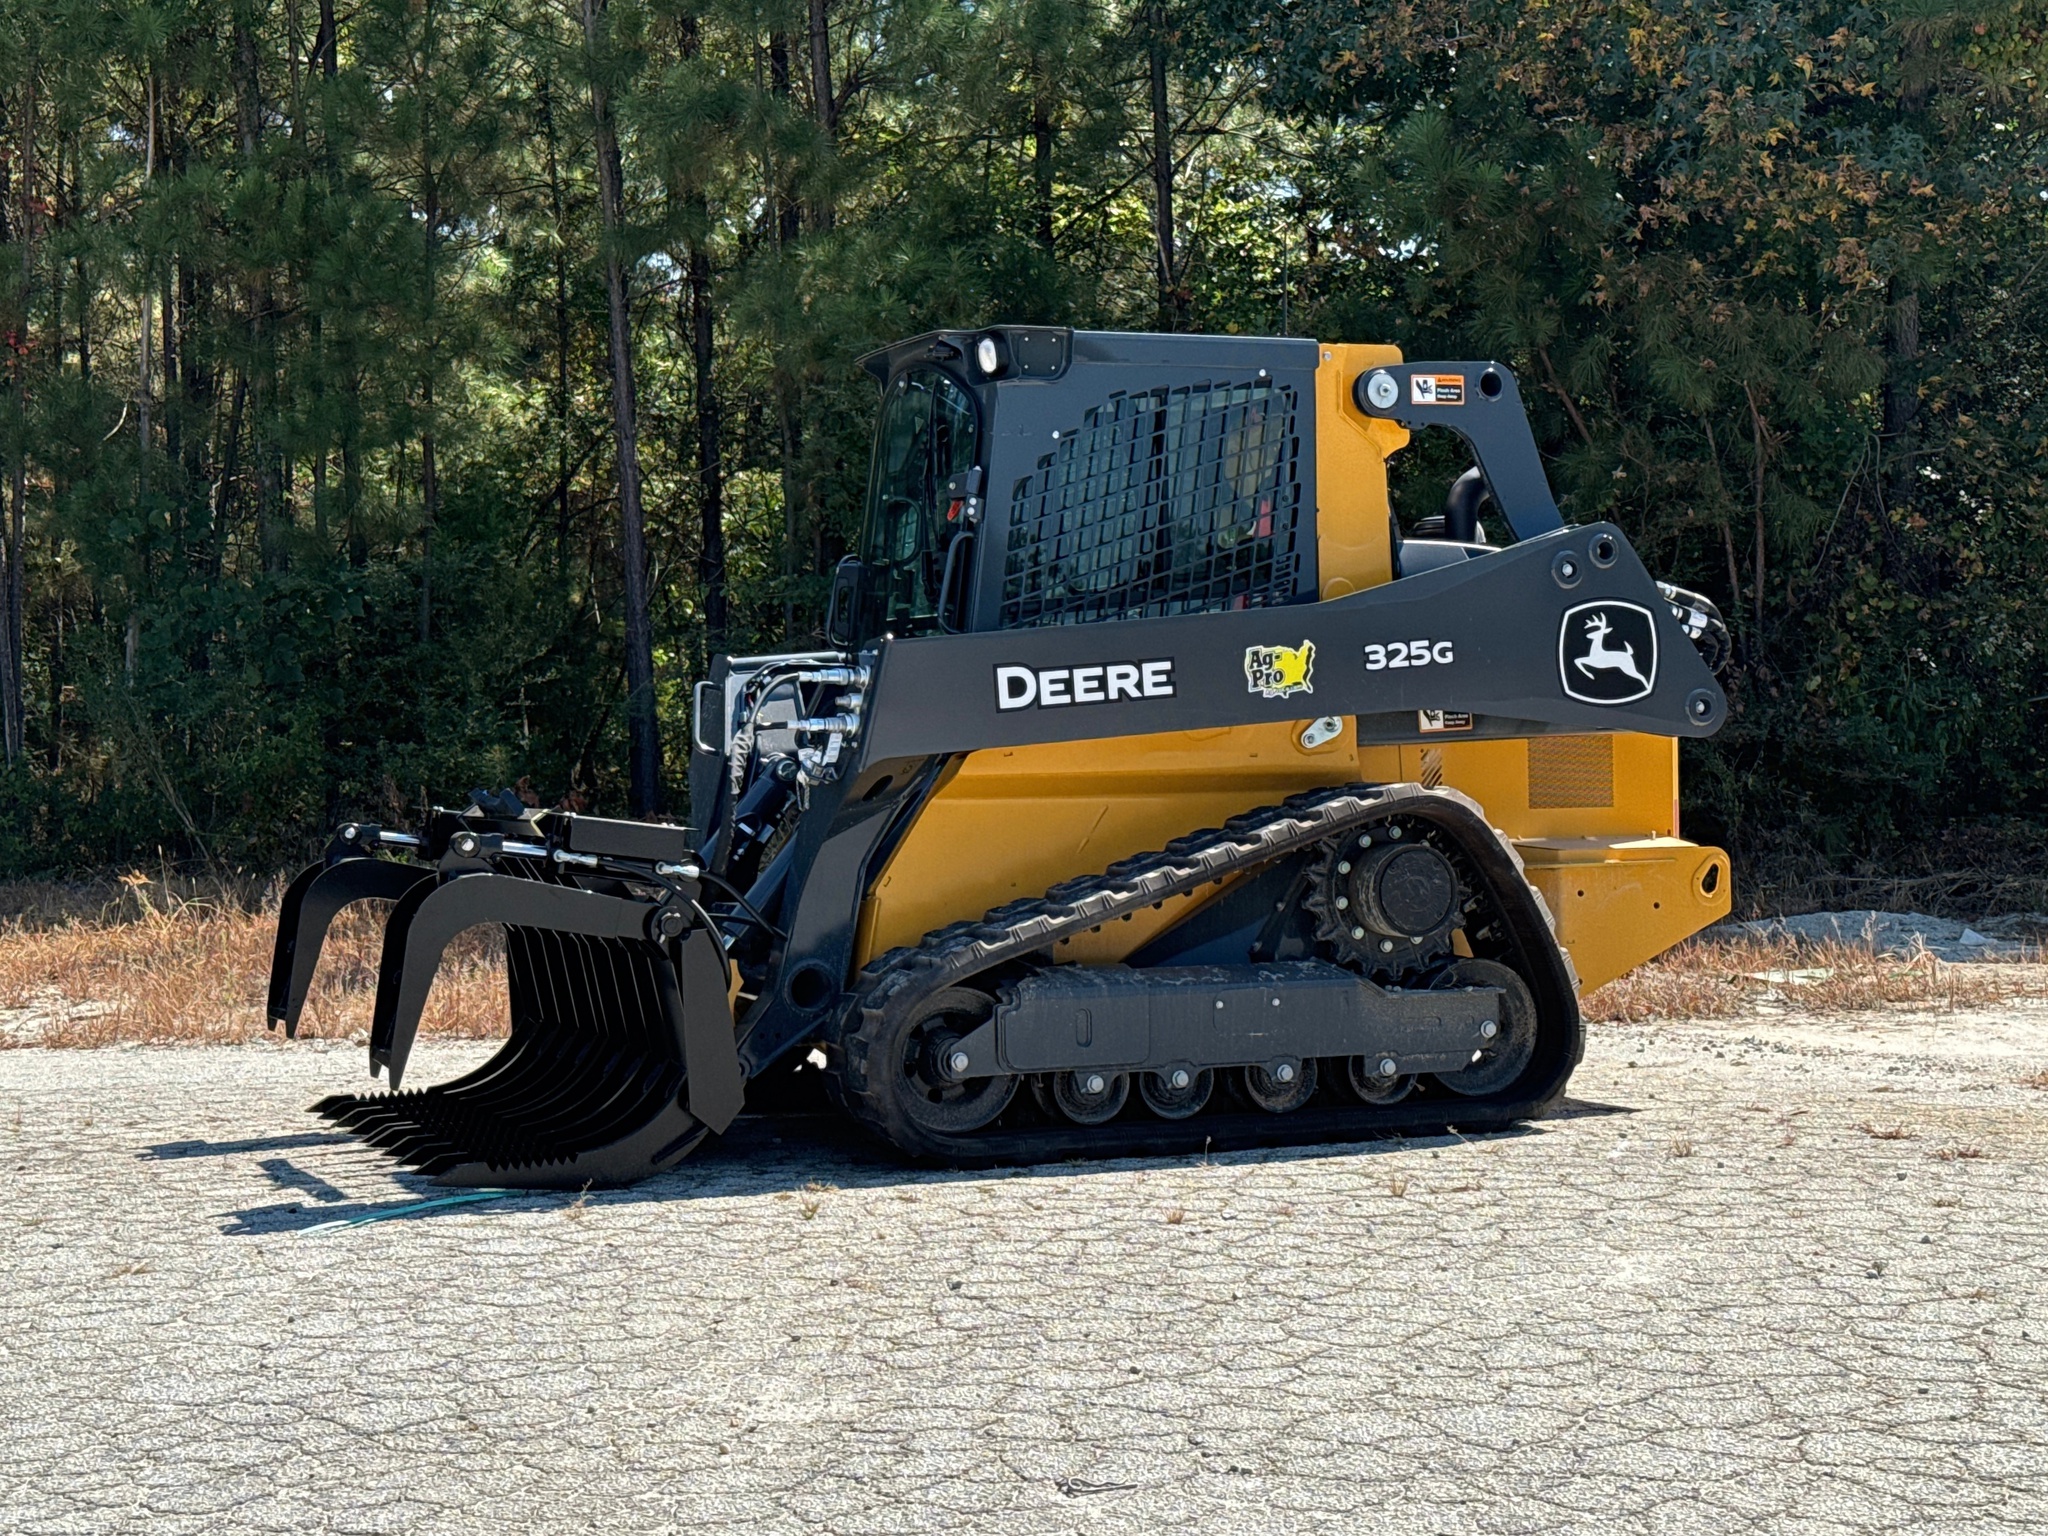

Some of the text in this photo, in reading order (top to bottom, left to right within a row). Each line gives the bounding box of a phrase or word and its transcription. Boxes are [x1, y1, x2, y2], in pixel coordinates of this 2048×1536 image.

[1249, 650, 1281, 671] Ag-
[1364, 639, 1454, 671] 325G
[996, 660, 1174, 710] DEERE
[1251, 669, 1285, 688] Pro
